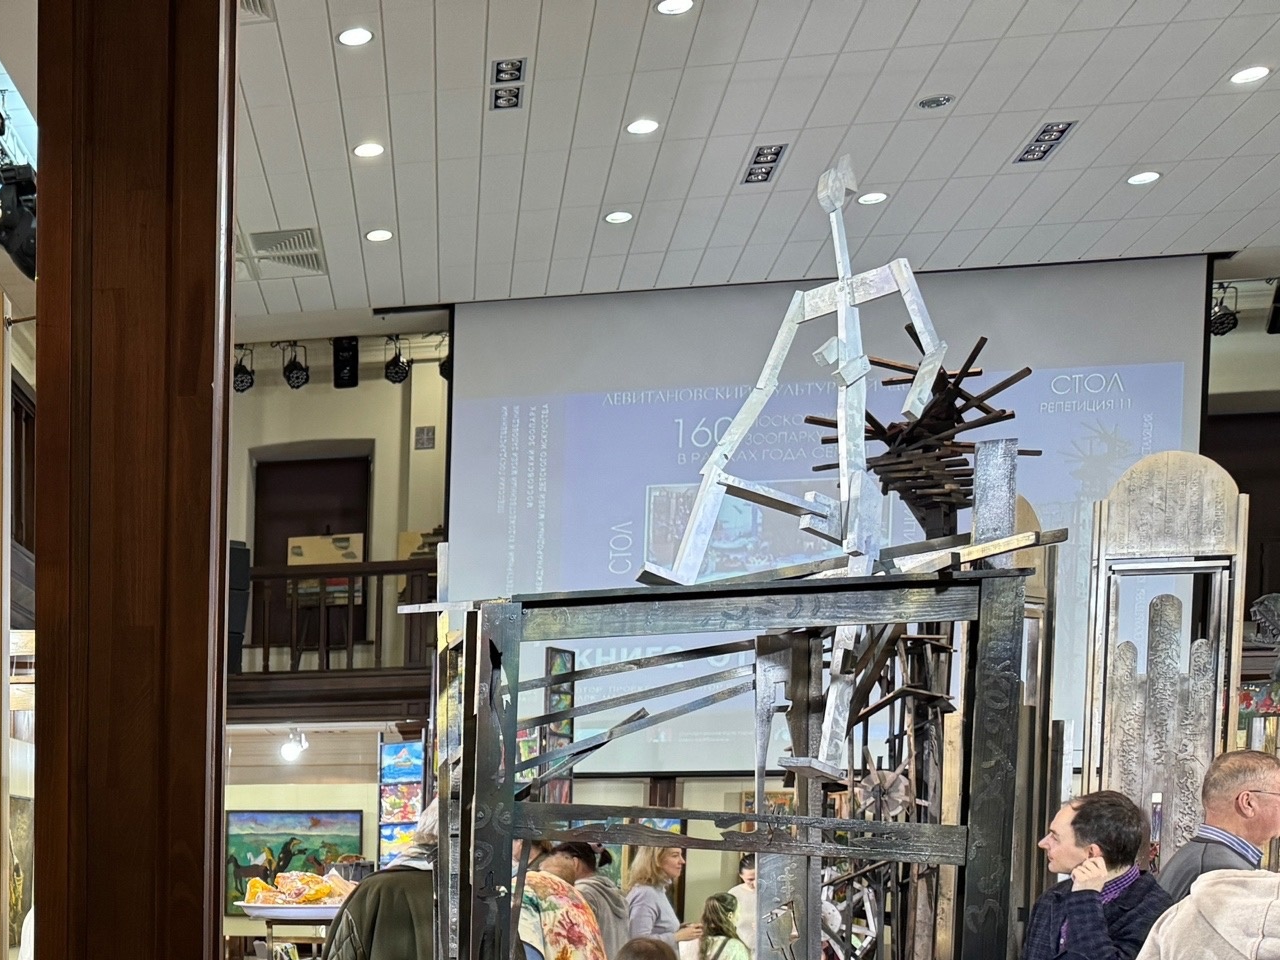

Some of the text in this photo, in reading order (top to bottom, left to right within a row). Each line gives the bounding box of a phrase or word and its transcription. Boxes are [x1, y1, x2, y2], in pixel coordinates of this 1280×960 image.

[1051, 372, 1125, 395] СТОЛ
[1040, 398, 1114, 413] РЕПЕТИЦИЯ
[539, 403, 550, 450] ИСКУССТВА
[526, 405, 538, 509] МОСКОВСКИЙ ЗООПАРК
[538, 451, 548, 492] ДЕТСКОГО
[762, 446, 807, 463] ГОДА
[608, 520, 634, 576] СТОЛ
